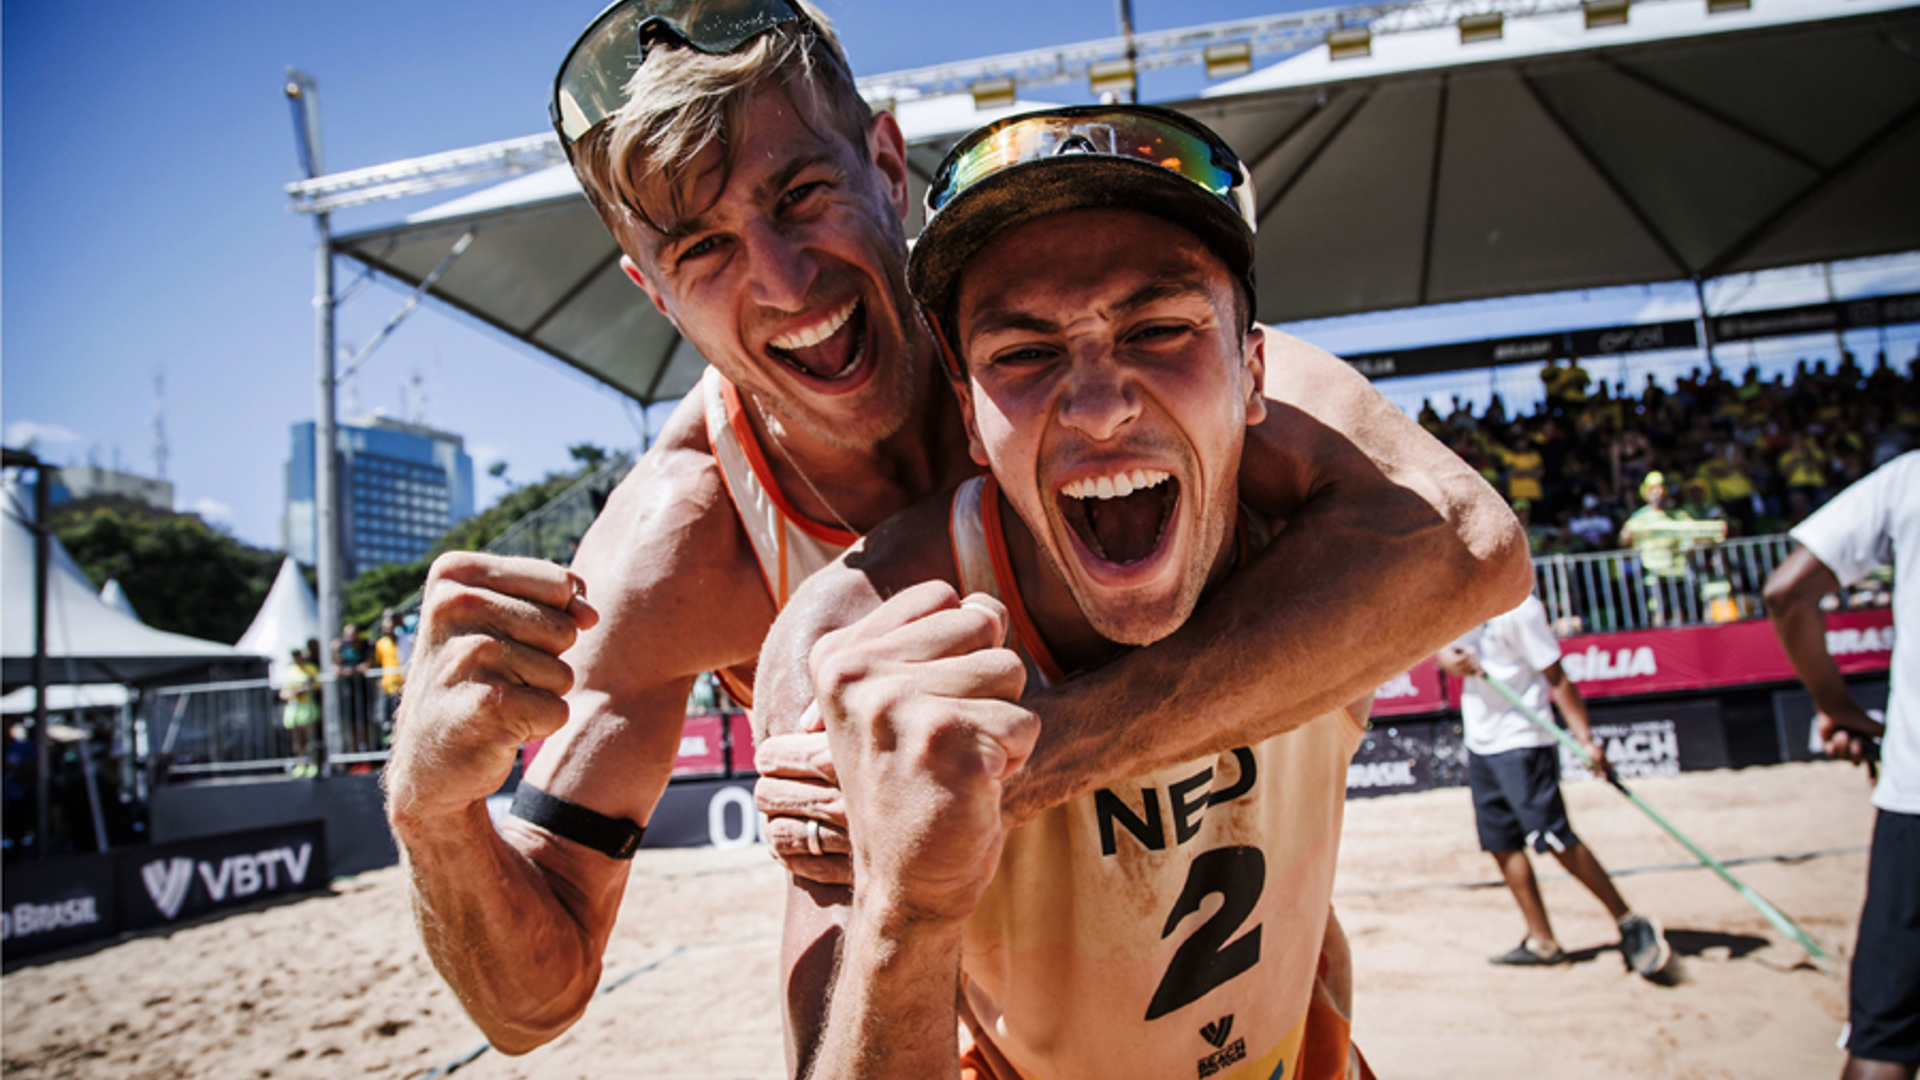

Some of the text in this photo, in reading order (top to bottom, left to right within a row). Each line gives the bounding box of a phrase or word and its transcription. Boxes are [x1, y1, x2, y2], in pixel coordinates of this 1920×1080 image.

[1094, 746, 1257, 856] NED
[199, 842, 312, 901] VBTV
[13, 896, 99, 937] BRASIL
[1144, 845, 1266, 1021] 2
